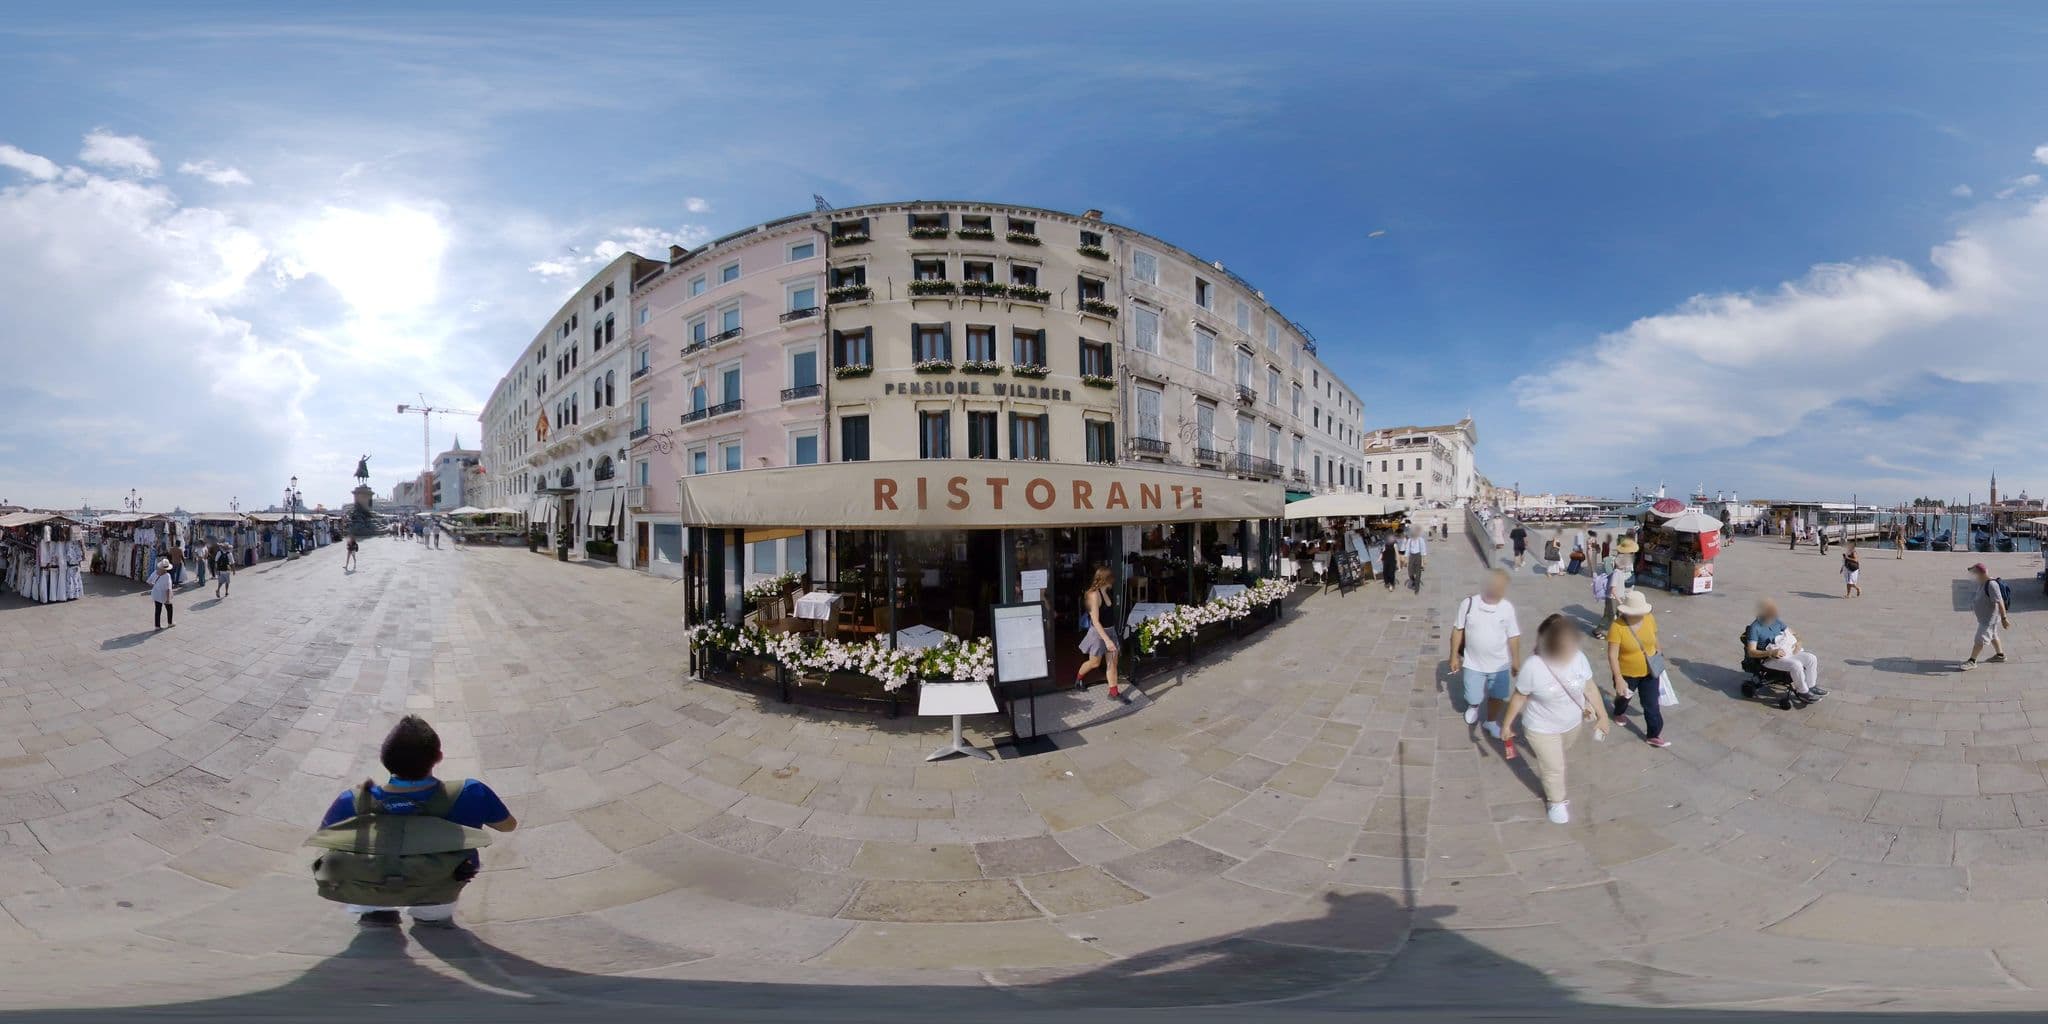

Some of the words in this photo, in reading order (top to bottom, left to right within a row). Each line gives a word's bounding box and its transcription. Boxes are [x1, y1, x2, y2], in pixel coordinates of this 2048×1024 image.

[885, 381, 980, 396] PENSIONE
[993, 383, 1072, 401] WILDNER
[873, 476, 1203, 511] RISTORANTE
